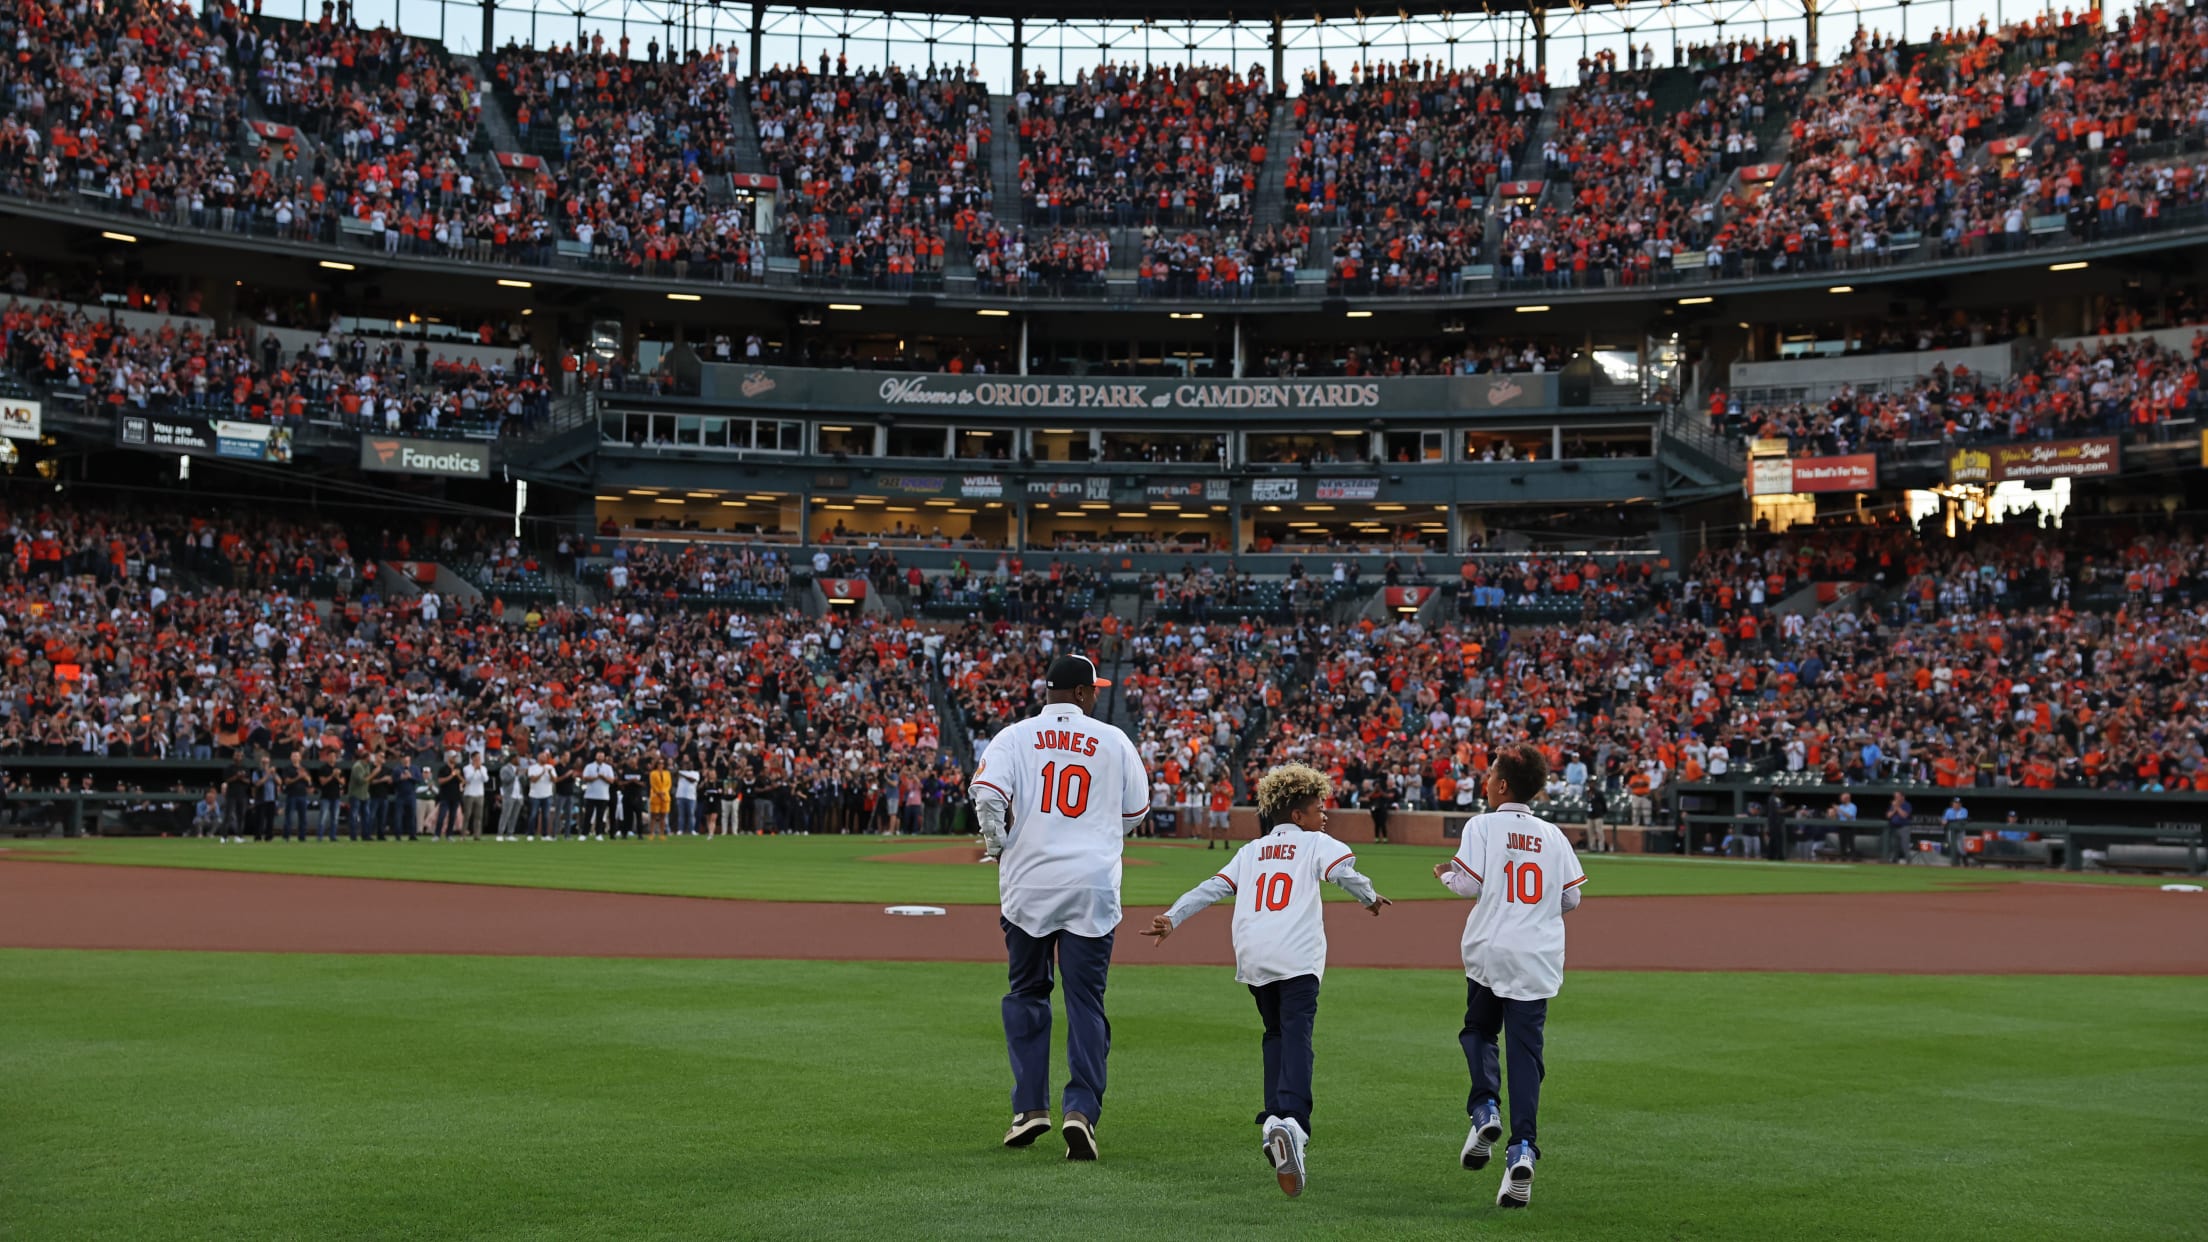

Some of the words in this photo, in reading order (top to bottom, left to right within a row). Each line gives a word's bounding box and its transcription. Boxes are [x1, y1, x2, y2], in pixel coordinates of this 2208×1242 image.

[880, 376, 957, 404] Welcome
[957, 389, 975, 405] to
[975, 383, 1076, 408] ORIOLE
[1078, 384, 1148, 408] PARK
[1174, 385, 1292, 408] CAMDEN
[1293, 384, 1379, 408] YARDS
[152, 421, 173, 434] You
[175, 425, 194, 436] are
[154, 434, 173, 444] not
[174, 435, 206, 448] alone.
[402, 447, 480, 472] Fanatics
[2005, 462, 2108, 477] SafferPlumbing.com
[963, 476, 1001, 486] WBAL
[1034, 729, 1099, 757] JONES
[1040, 760, 1092, 819] 10
[1258, 844, 1297, 861] JONES
[1506, 832, 1542, 853] JONES
[1254, 872, 1293, 912] 10
[1504, 860, 1543, 904] 10
